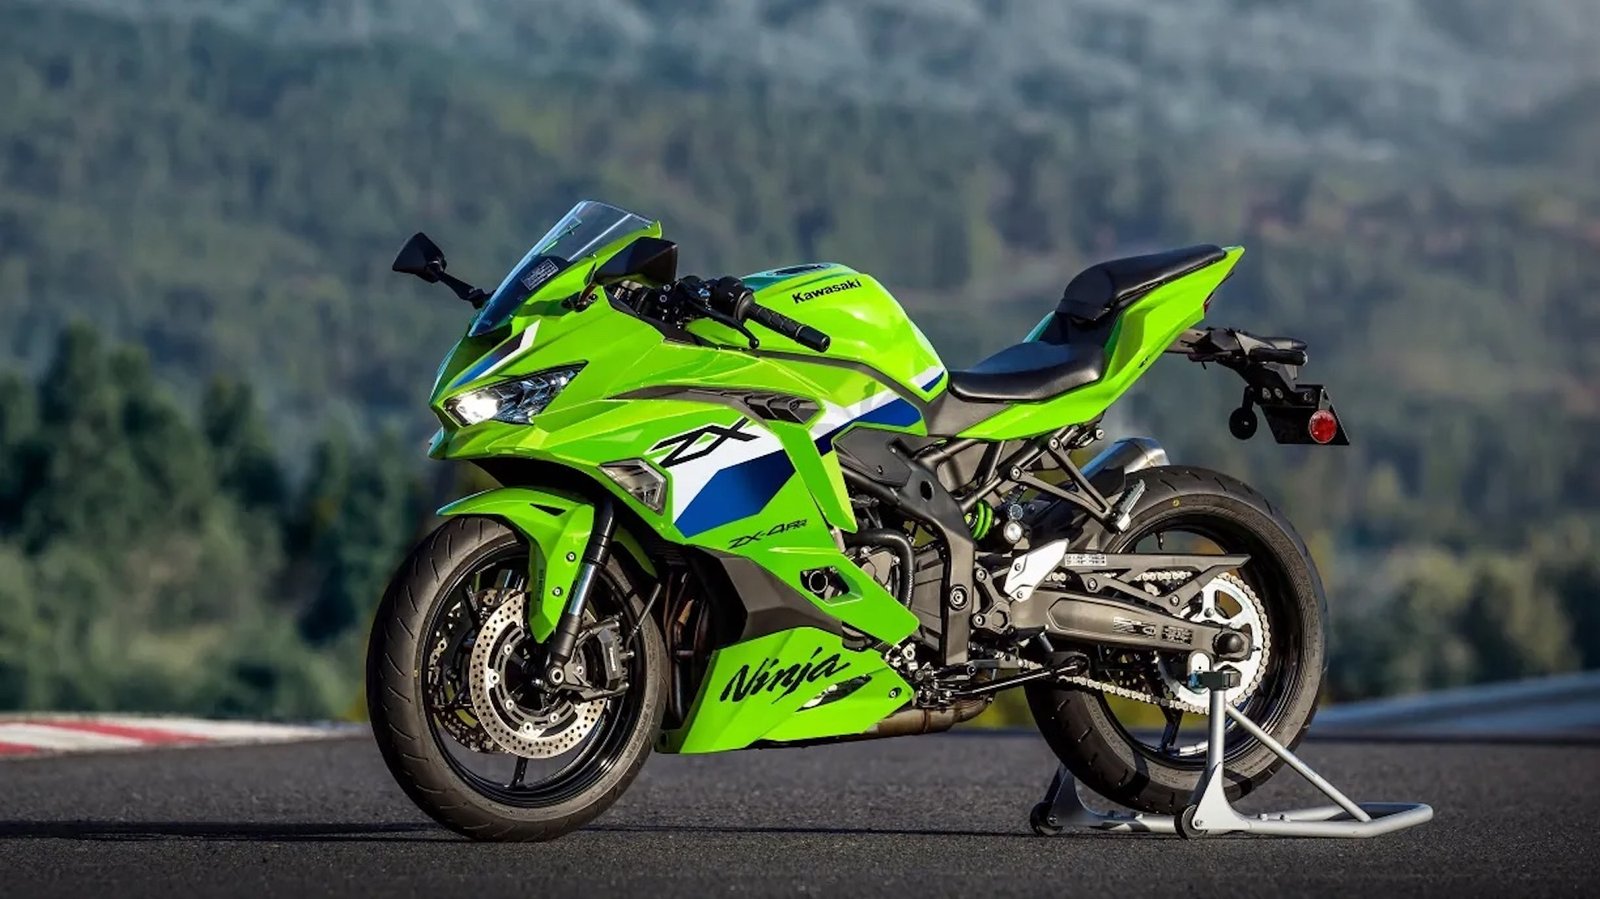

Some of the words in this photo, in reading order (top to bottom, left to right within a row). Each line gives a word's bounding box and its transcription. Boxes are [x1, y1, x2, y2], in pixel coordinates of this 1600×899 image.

[792, 279, 862, 304] Kawasaki
[650, 416, 761, 468] ZX
[719, 646, 851, 705] Ninja
